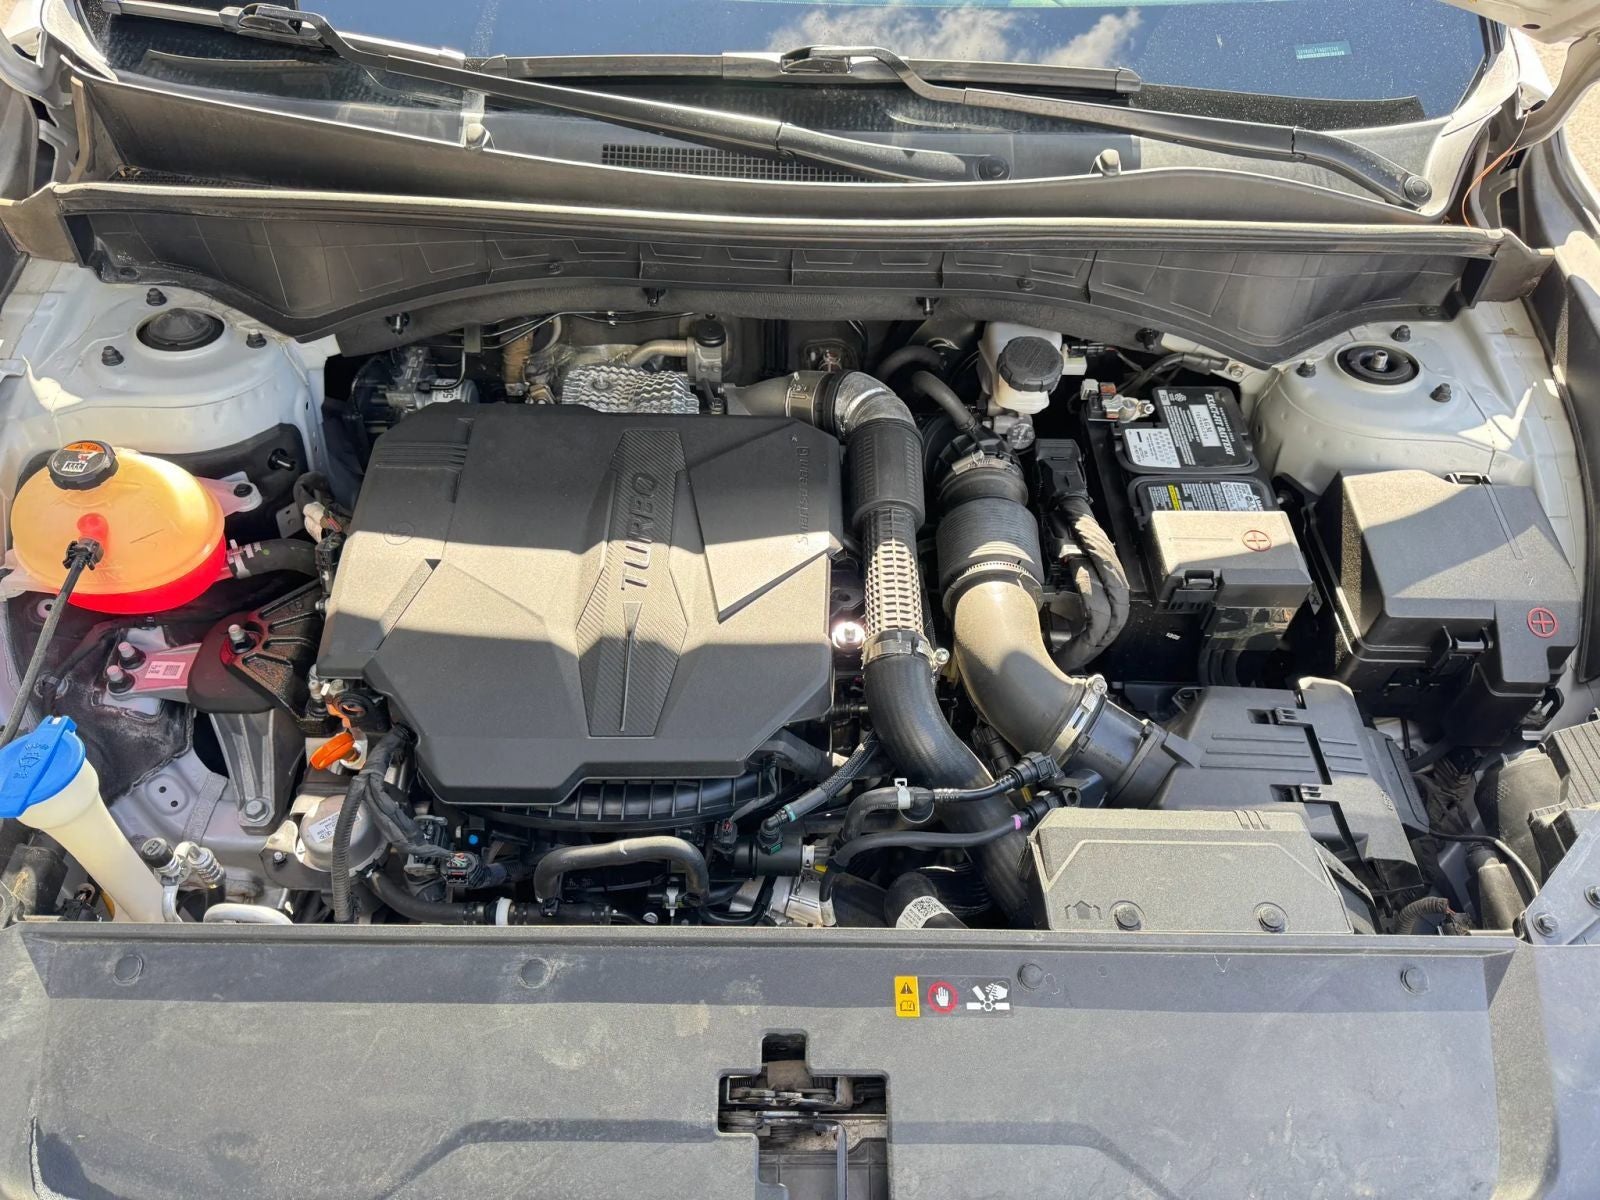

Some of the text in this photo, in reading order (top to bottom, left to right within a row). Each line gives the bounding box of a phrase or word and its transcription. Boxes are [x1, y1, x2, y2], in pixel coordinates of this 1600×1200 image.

[1205, 393, 1235, 456] EXACT-FIT BATTERY
[620, 473, 657, 591] TURBO
